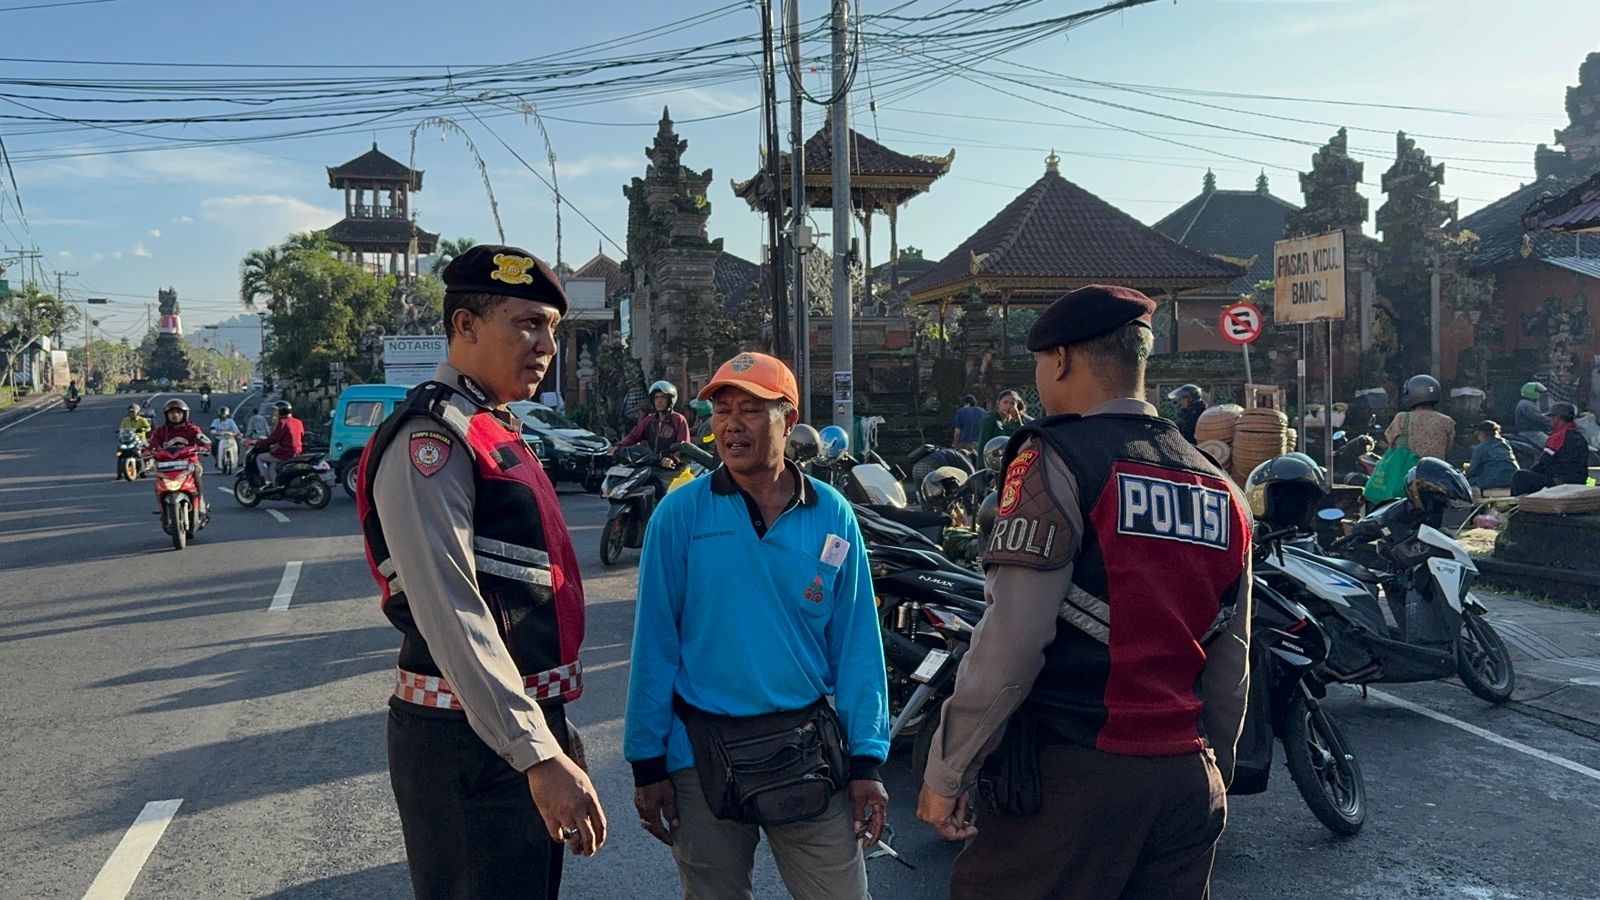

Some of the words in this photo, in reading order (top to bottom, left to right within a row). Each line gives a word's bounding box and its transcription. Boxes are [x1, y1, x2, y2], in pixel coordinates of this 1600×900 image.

[1278, 251, 1310, 278] PASAR
[389, 341, 442, 350] NOTARIS
[1124, 480, 1227, 544] POLISI
[1281, 640, 1304, 653] HONDA
